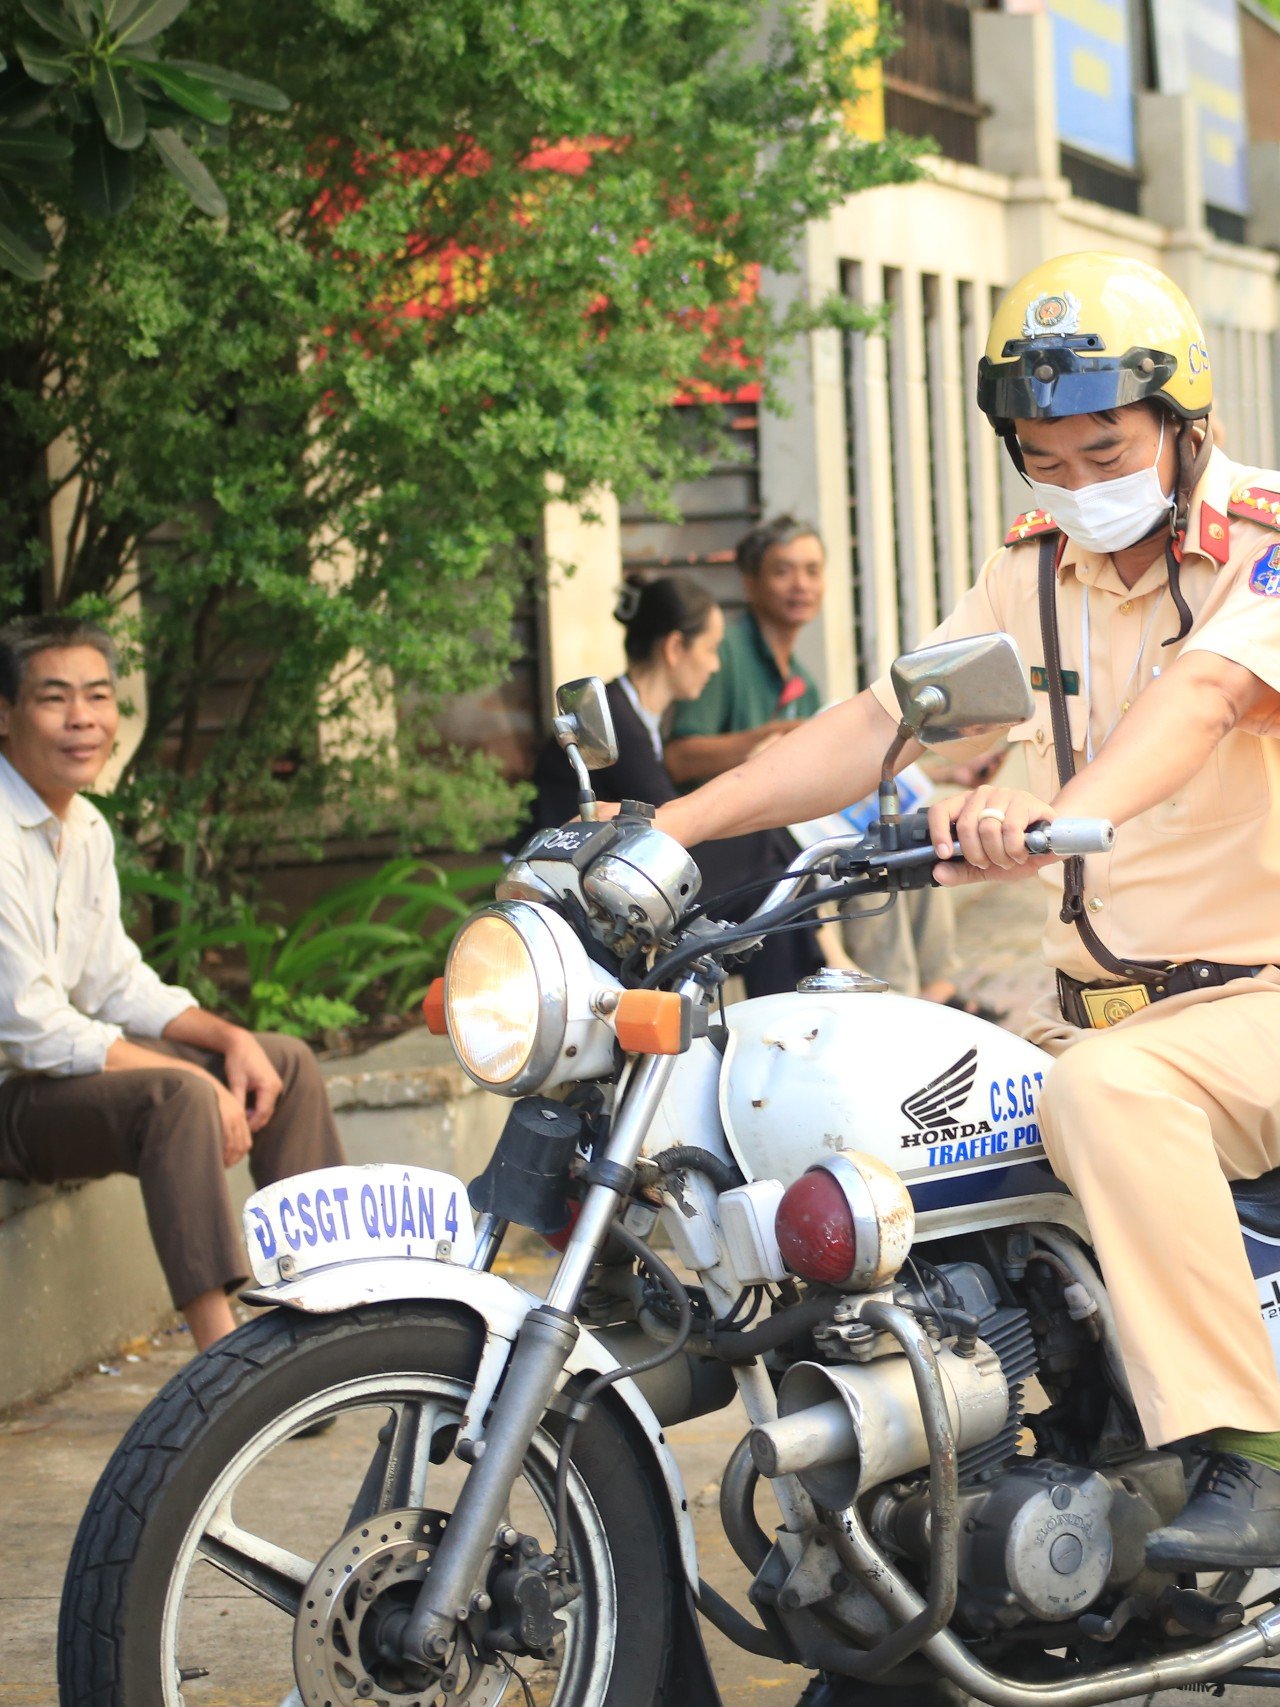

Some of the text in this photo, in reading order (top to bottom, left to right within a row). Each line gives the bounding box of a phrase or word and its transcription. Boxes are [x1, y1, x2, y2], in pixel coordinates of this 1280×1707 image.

[901, 1120, 992, 1148] HONDA
[927, 1123, 1042, 1168] TRAFFIC PO
[280, 1187, 350, 1251] CSGT
[361, 1172, 435, 1257] QUẬN
[444, 1191, 458, 1243] 4
